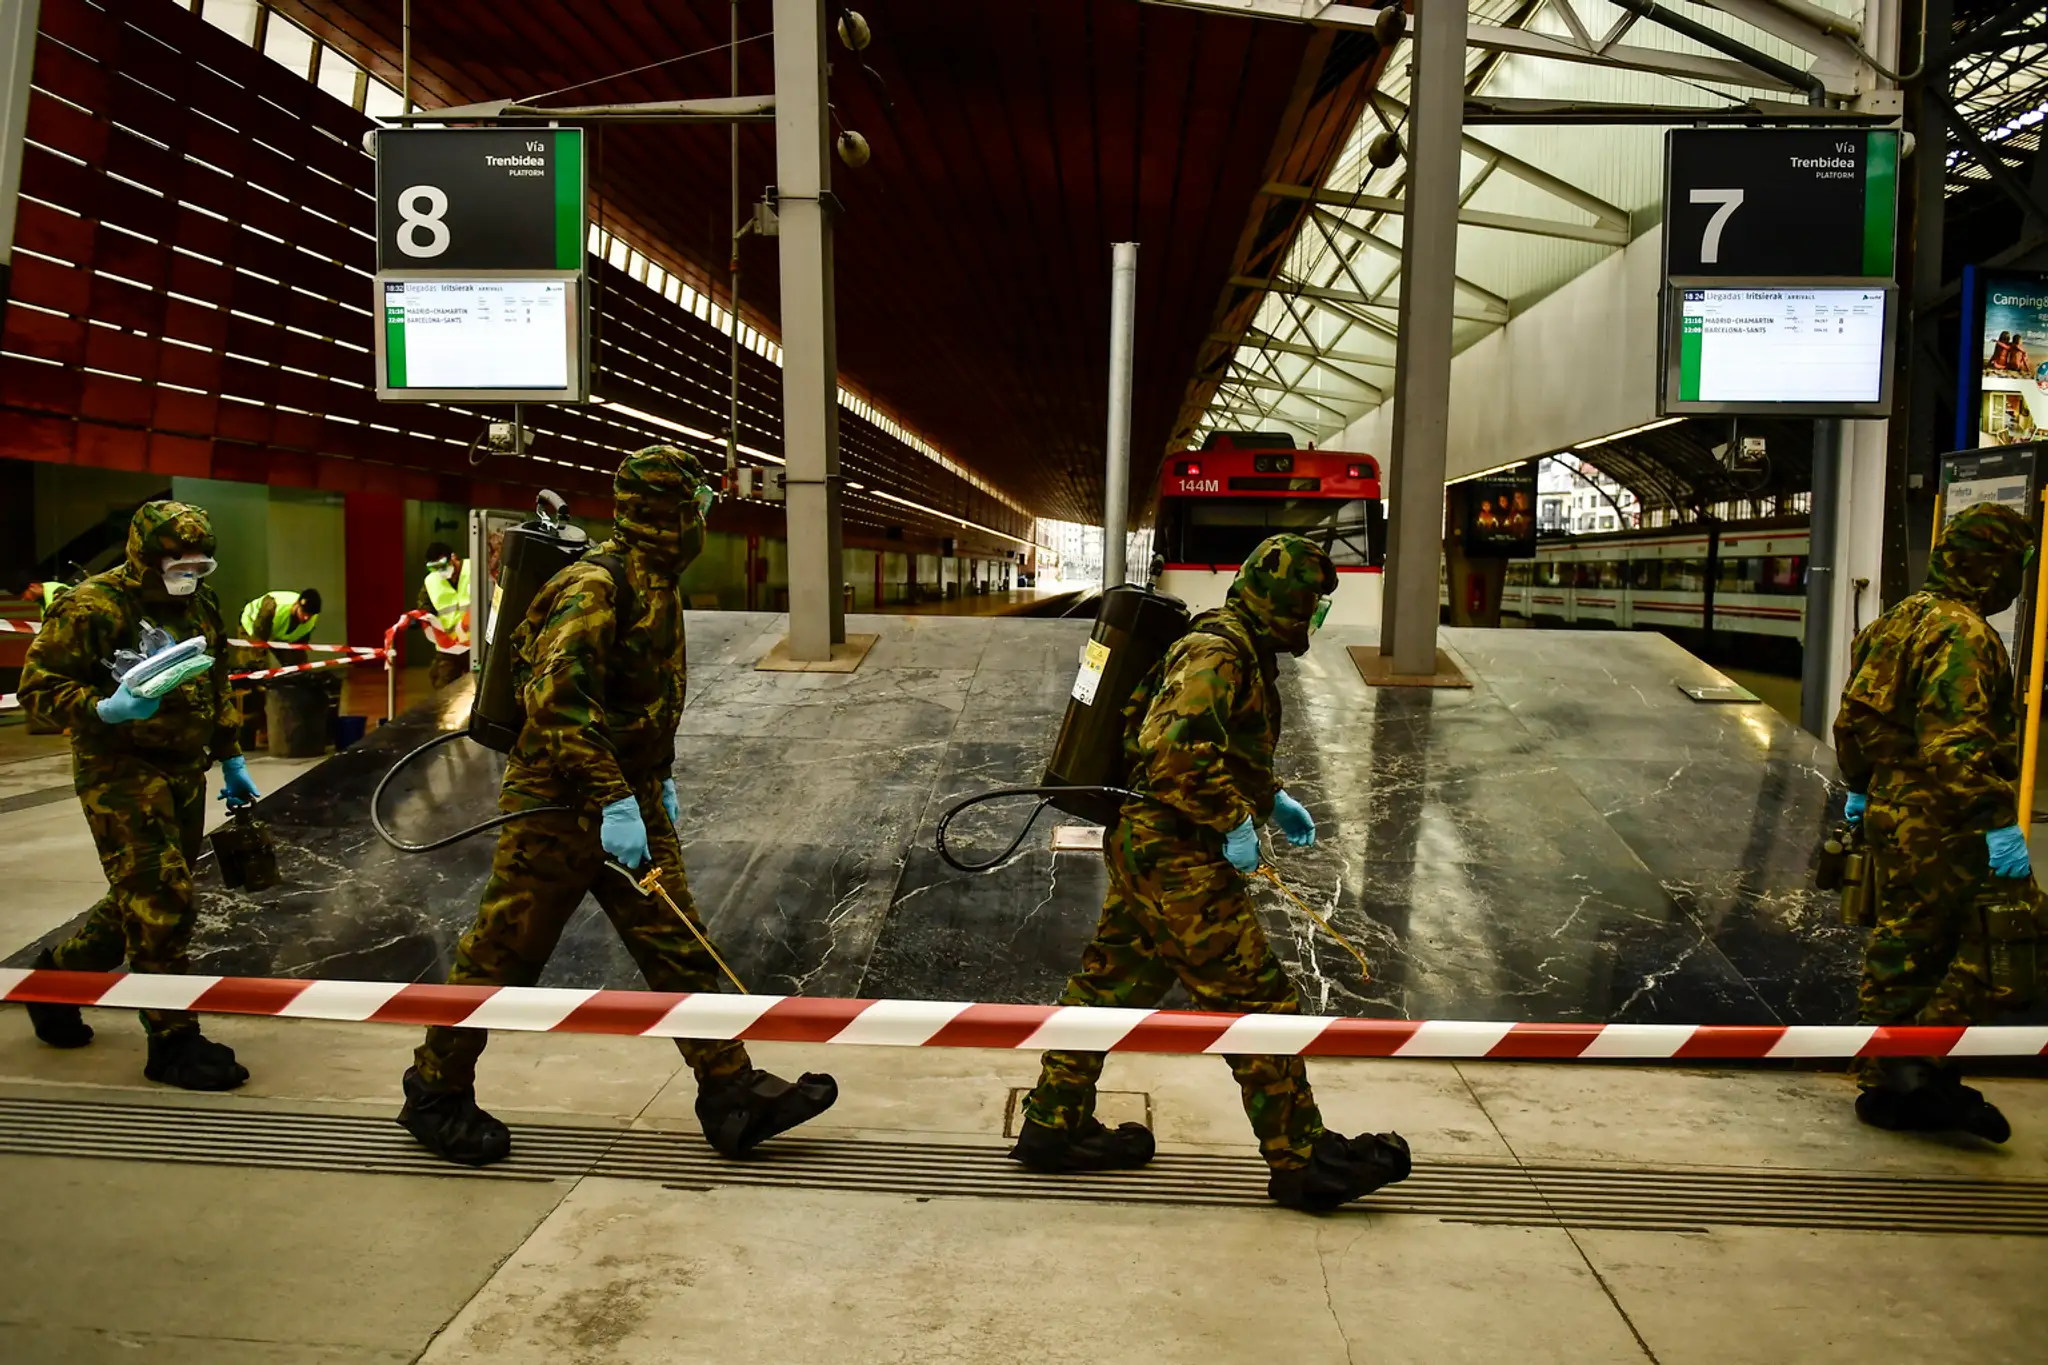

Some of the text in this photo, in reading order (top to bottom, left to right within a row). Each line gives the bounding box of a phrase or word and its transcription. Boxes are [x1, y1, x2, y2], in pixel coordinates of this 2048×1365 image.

[525, 140, 545, 152] Vía
[1835, 141, 1855, 153] Vía
[485, 155, 545, 166] Trenbidea
[1790, 157, 1855, 168] Trenbidea
[1816, 171, 1855, 179] PLATFORM
[396, 185, 451, 259] 8
[1690, 189, 1744, 263] 7
[1707, 292, 1740, 301] Llegadas
[1746, 292, 1782, 300] Iritsierak
[1179, 479, 1219, 492] 144M
